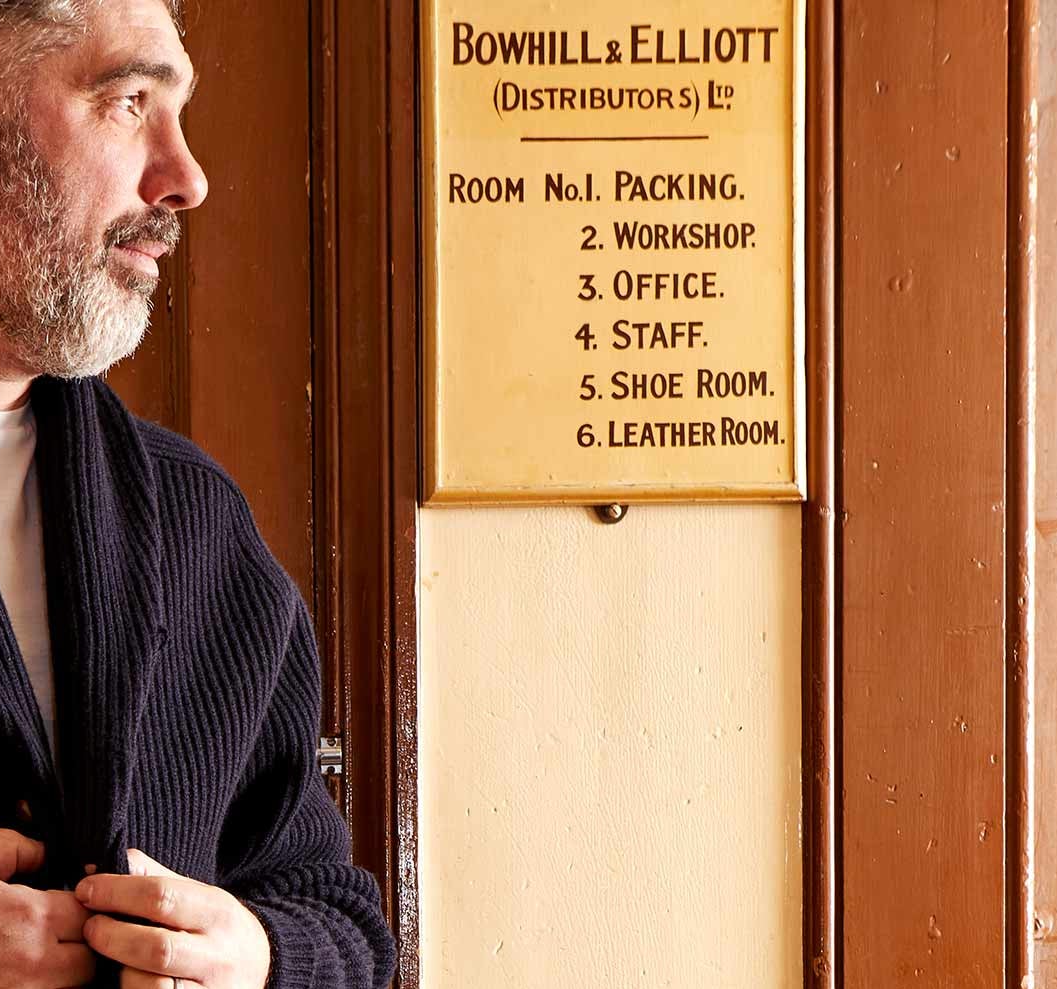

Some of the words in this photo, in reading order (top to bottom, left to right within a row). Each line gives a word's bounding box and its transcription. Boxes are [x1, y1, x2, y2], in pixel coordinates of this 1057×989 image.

[453, 22, 601, 65] BOWHILL
[605, 40, 622, 64] &
[631, 25, 778, 64] ELLIOTT
[449, 174, 524, 203] ROOM
[615, 171, 744, 201] PACKING.
[581, 226, 603, 250] 2.
[613, 221, 755, 250] WORKSHOP.
[578, 275, 602, 301] 3.
[614, 270, 724, 300] OFFICE.
[575, 324, 597, 350] 4.
[613, 320, 707, 350] STAFF.
[580, 375, 602, 400] 5.
[611, 371, 683, 400] SHOE
[697, 369, 774, 398] ROOM.
[577, 424, 601, 447] 6.
[609, 421, 715, 447] LEATHER
[721, 417, 785, 445] ROOM.
